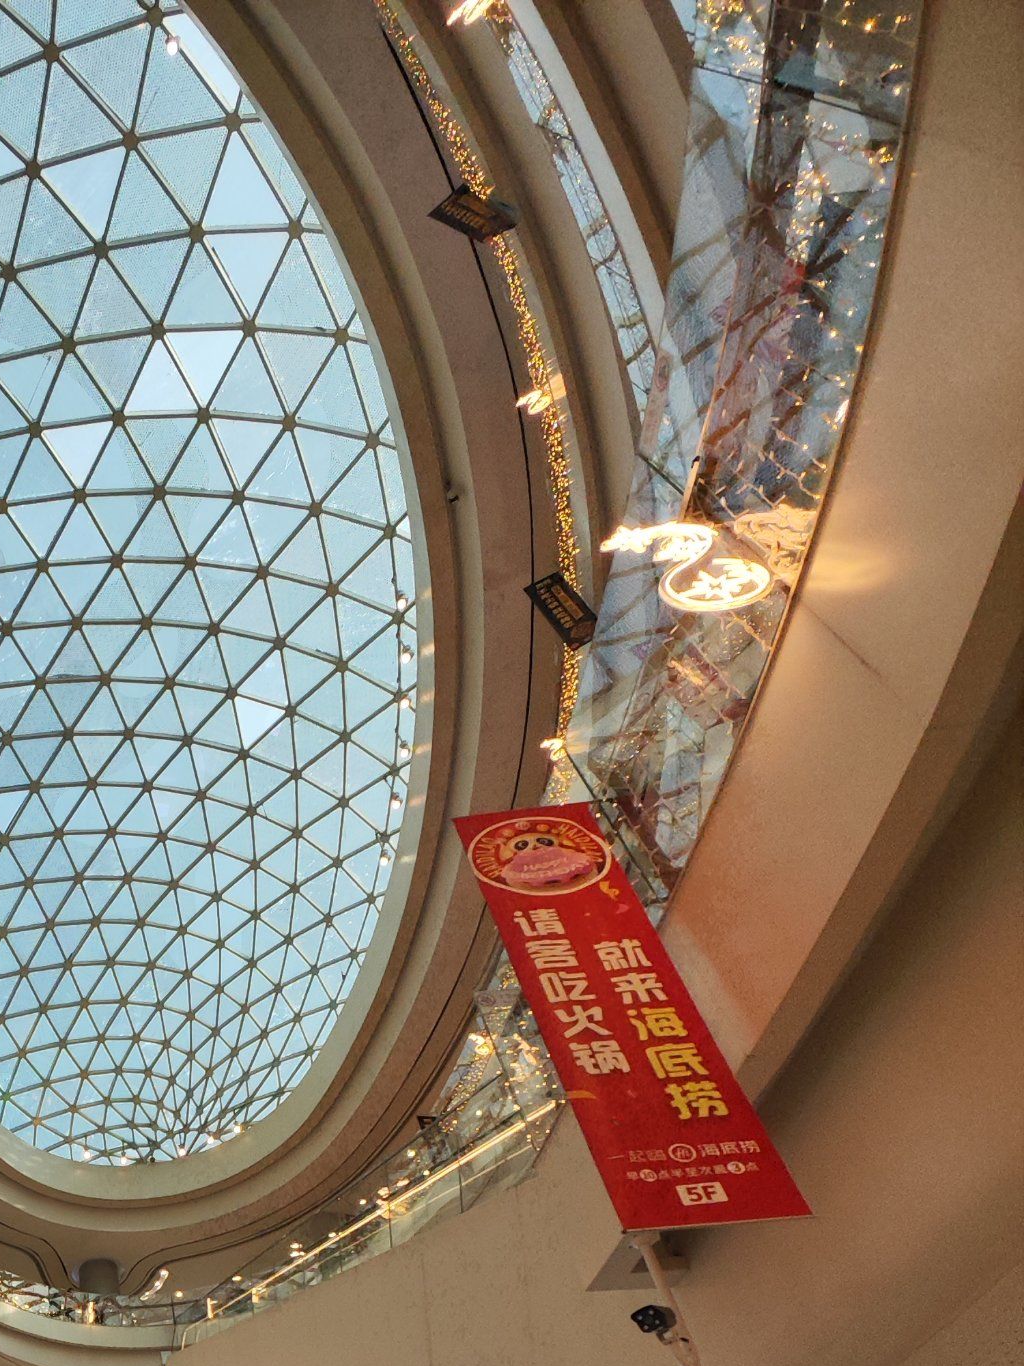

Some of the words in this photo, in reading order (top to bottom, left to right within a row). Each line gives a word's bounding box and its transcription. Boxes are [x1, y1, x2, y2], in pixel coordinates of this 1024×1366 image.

[513, 908, 631, 1075] 请客吃火锅
[593, 938, 729, 1120] 就来海底捞
[686, 1185, 718, 1202] 5F
